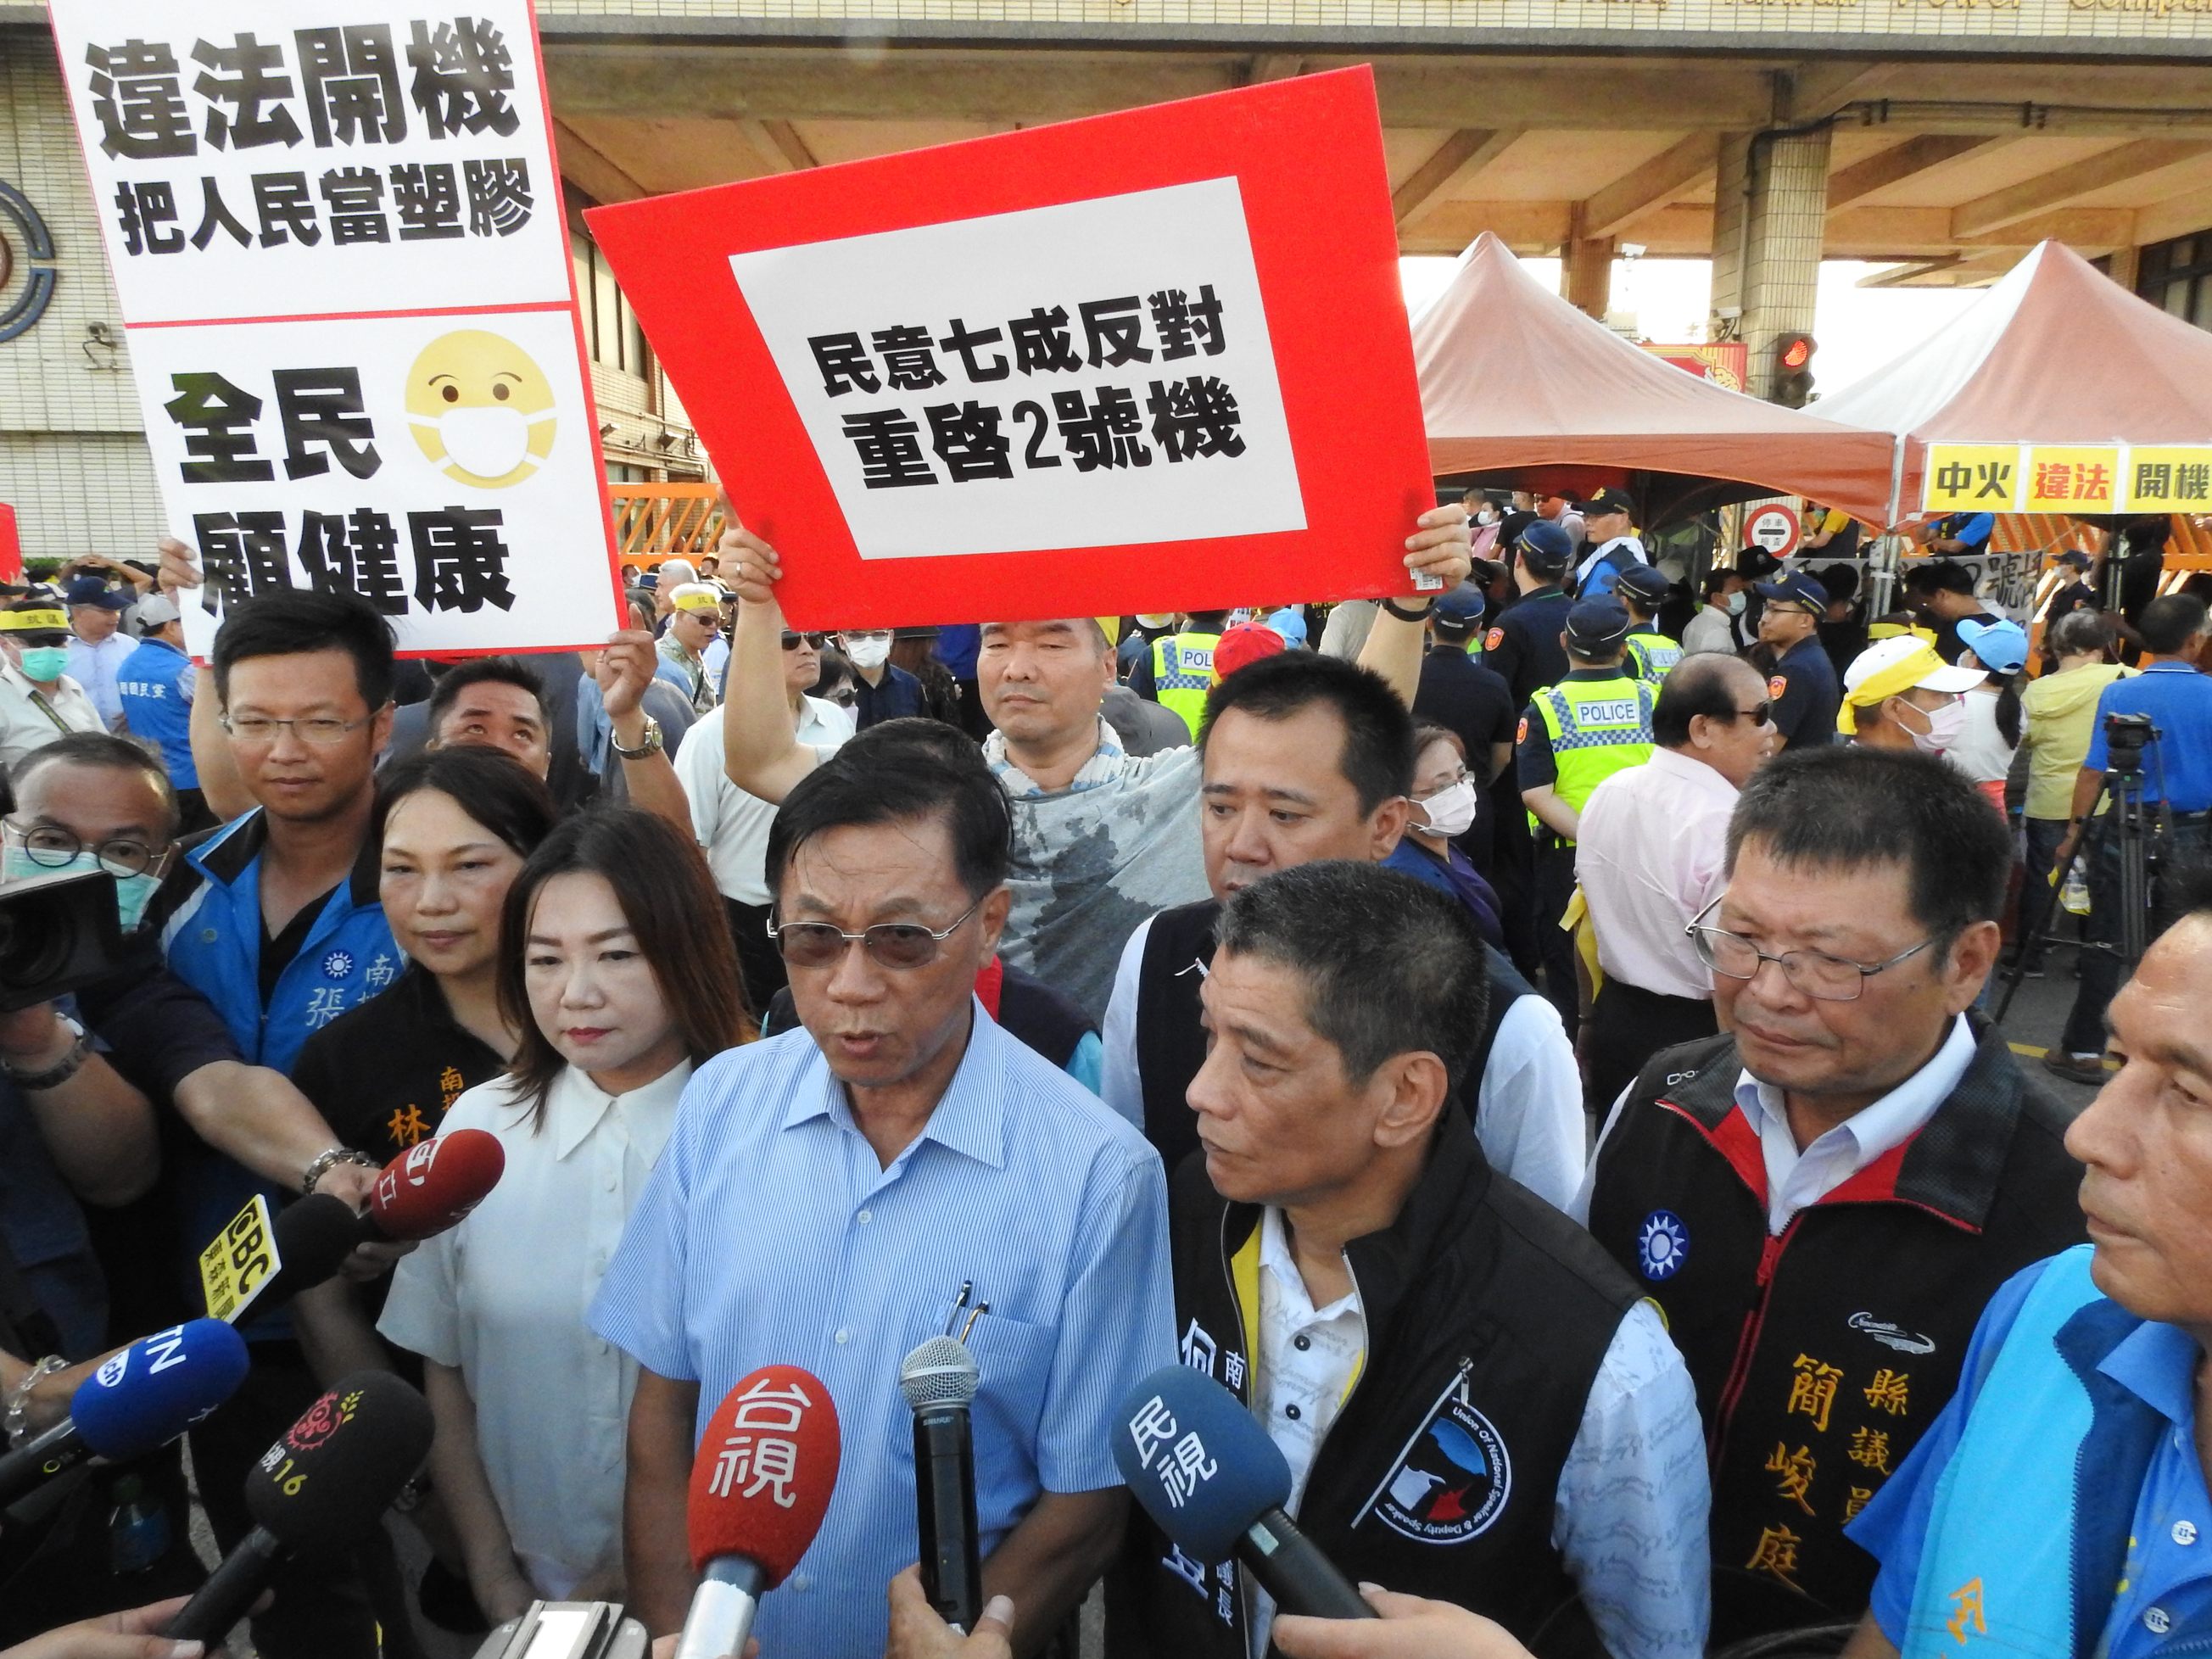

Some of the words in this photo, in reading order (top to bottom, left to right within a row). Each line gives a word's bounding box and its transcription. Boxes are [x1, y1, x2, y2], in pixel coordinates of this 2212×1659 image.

[86, 17, 522, 161] 違法開機
[115, 158, 534, 256] 把人民當塑膠
[807, 284, 1226, 399] 民意七成反對
[163, 366, 383, 483] 全民
[1937, 461, 2011, 498] 中火
[2035, 462, 2110, 500] 違法
[2134, 463, 2210, 500] 開機
[193, 506, 517, 623] 顧健康
[1183, 652, 1211, 665] POL
[1580, 706, 1635, 720] POLICE
[306, 987, 345, 1029] 張
[1666, 1070, 1700, 1086] Cro
[388, 1103, 431, 1148] 林
[1452, 1406, 1479, 1431] Union
[1478, 1429, 1494, 1444] Of
[708, 1377, 812, 1509] 台視
[1127, 1394, 1219, 1509] 民視
[273, 1458, 308, 1495] 16
[1487, 1444, 1504, 1490] National
[1745, 1353, 1845, 1595] 簡峻庭
[1383, 1502, 1422, 1532] Speaker
[1463, 1519, 1473, 1531] &
[1472, 1489, 1501, 1523] Speaker
[1423, 1522, 1463, 1535] Deputy
